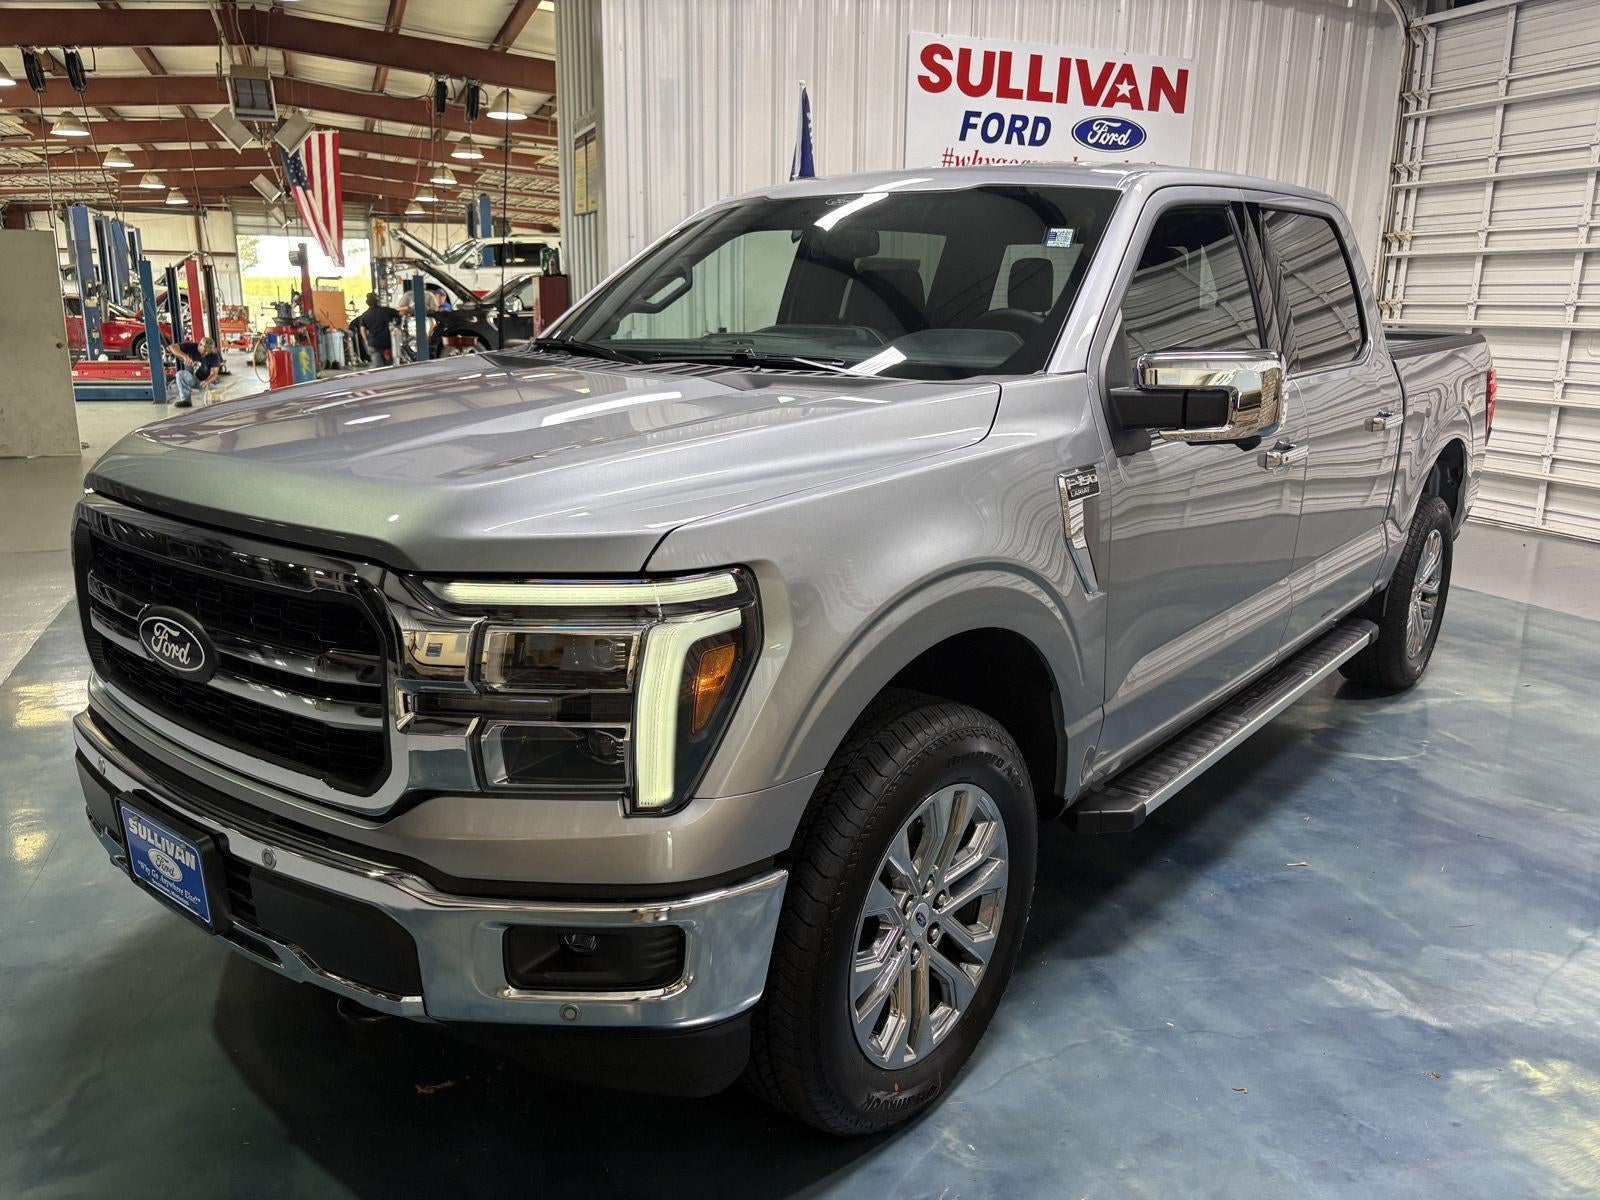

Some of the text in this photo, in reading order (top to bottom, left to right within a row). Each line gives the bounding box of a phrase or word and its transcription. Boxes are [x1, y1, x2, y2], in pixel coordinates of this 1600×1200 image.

[917, 43, 1189, 114] SULLIVAN
[958, 110, 1052, 148] FORD
[1086, 119, 1131, 147] Ford
[151, 622, 191, 665] Ford
[128, 815, 196, 871] SULLIVAN
[155, 853, 176, 877] Ford
